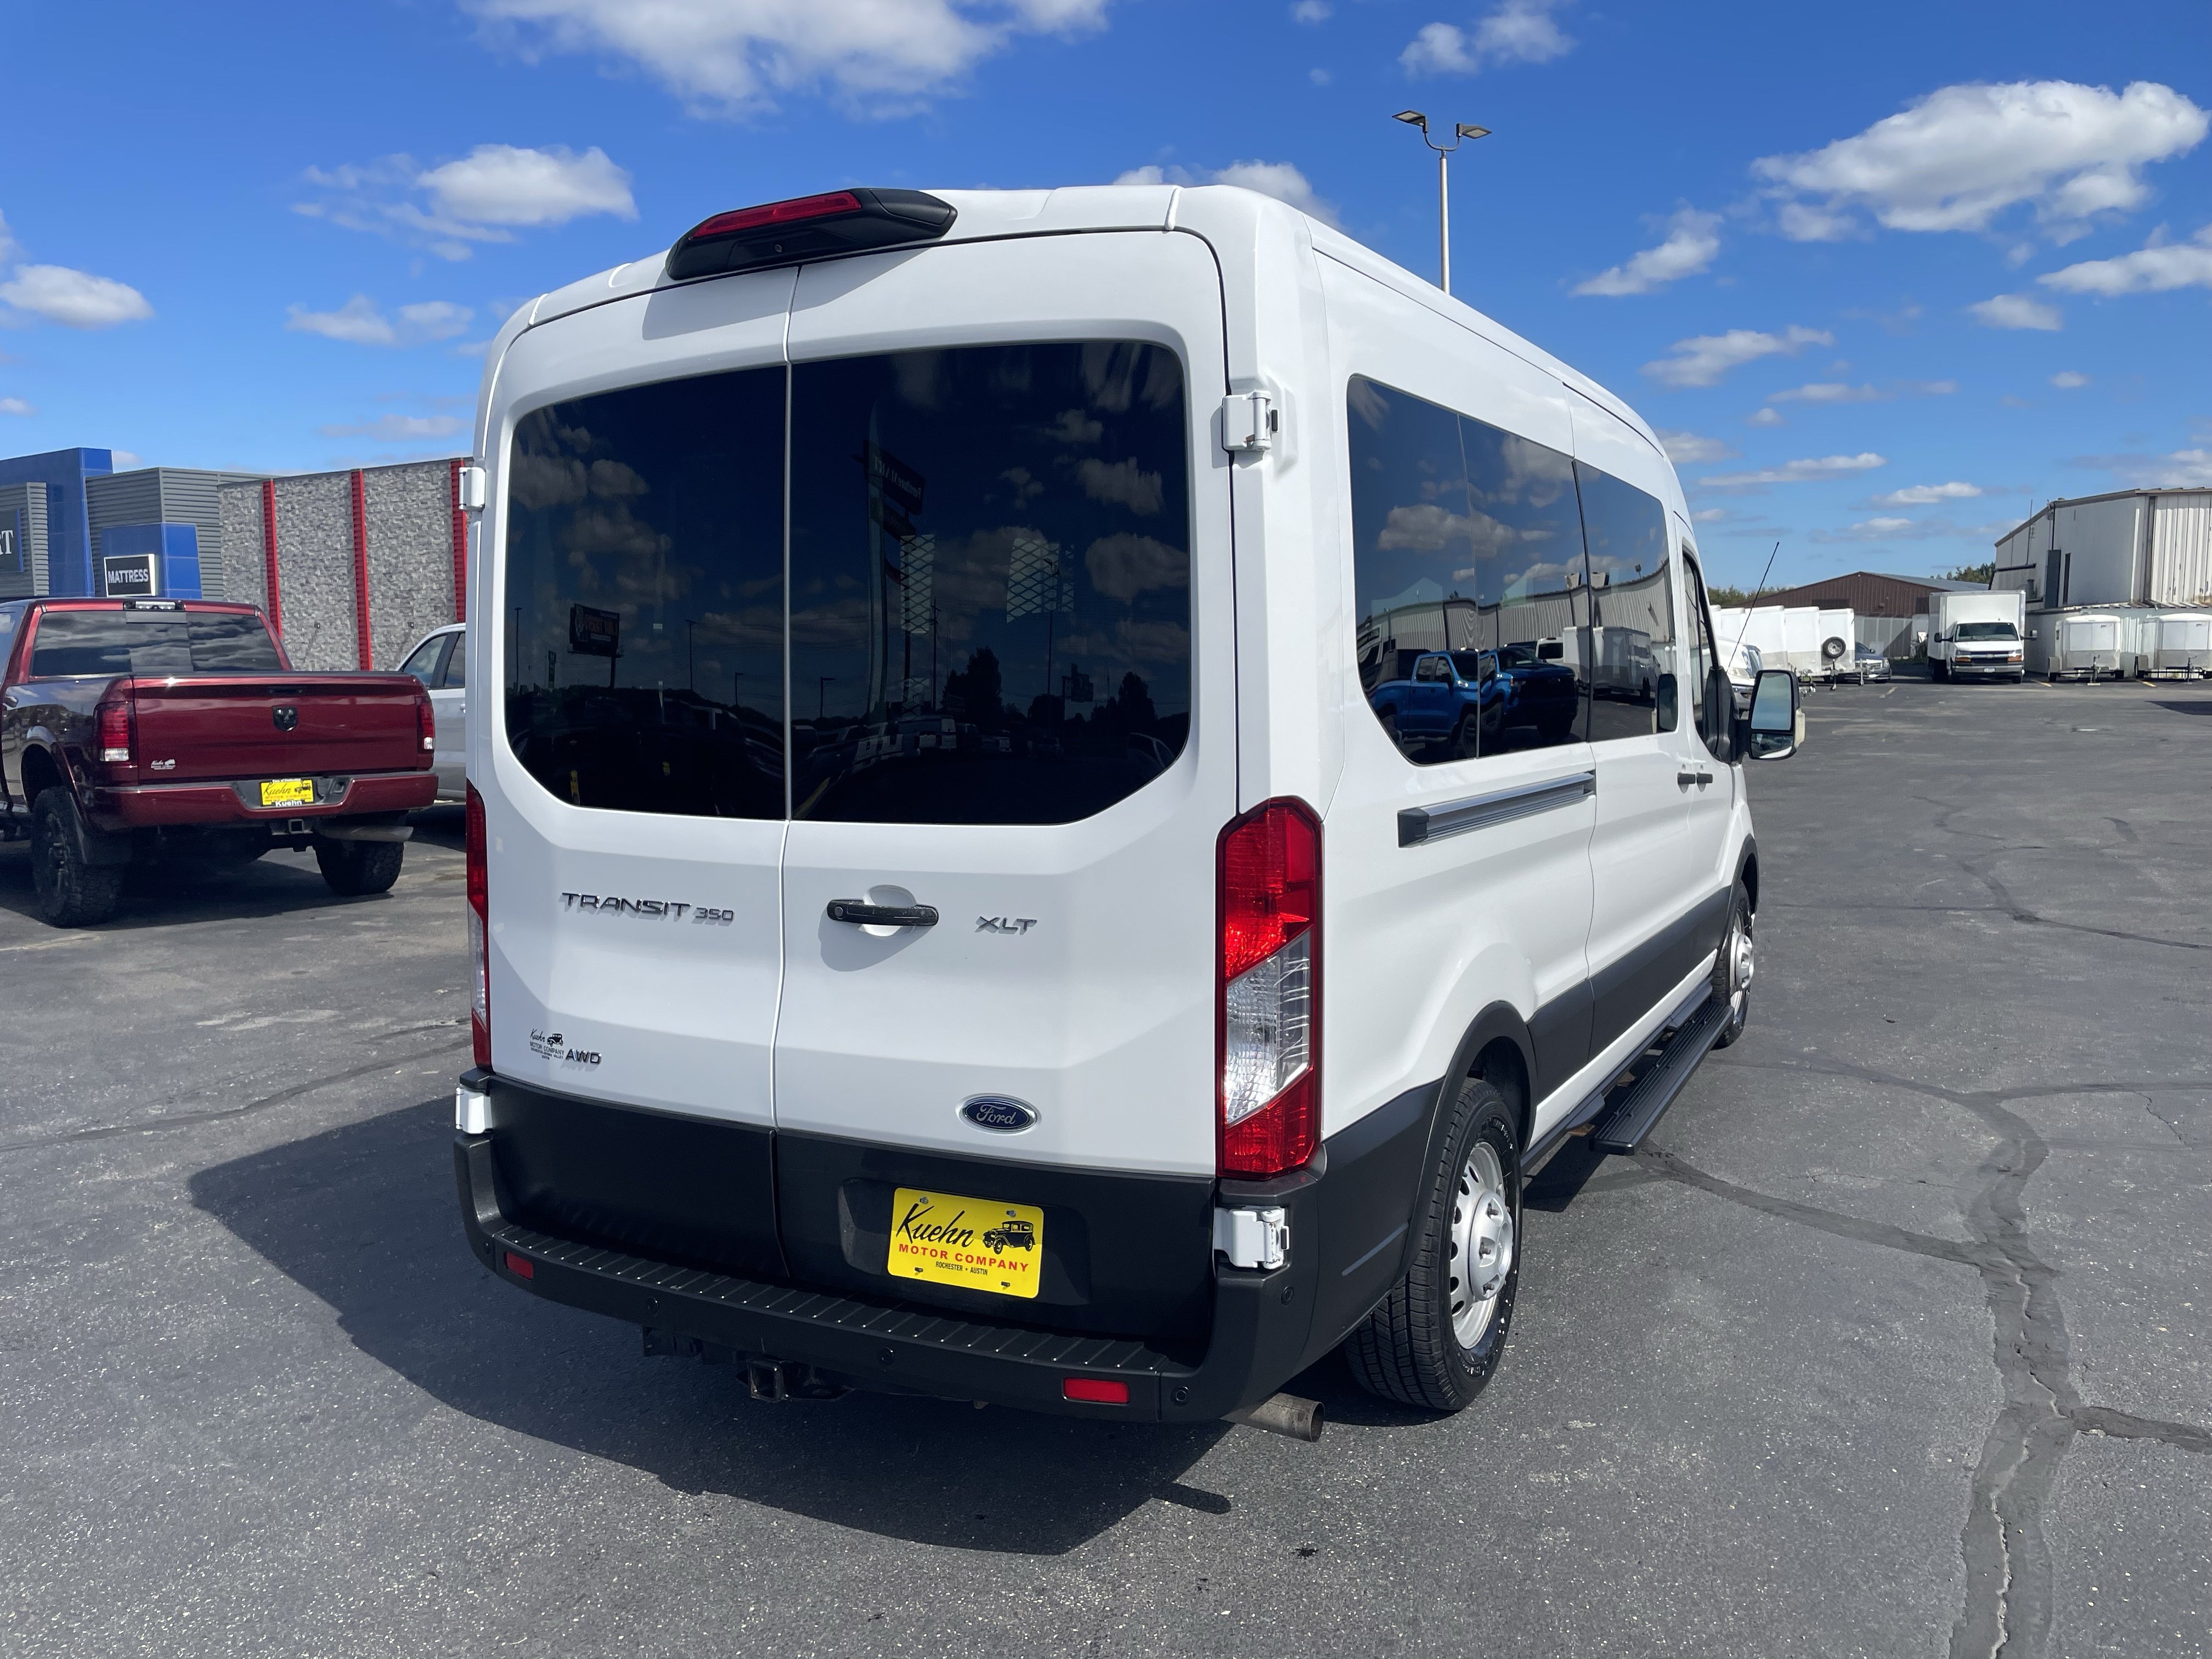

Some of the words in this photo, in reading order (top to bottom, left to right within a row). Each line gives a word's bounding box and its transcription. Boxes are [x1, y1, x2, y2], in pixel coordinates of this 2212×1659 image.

[0, 530, 14, 555] T
[108, 569, 149, 583] MATTRESS
[263, 783, 292, 796] Kuehn
[561, 892, 692, 917] TRANSIT
[695, 907, 735, 921] 350
[978, 916, 1037, 931] XLT
[530, 1028, 545, 1042] Kuehn
[530, 1041, 543, 1049] MOTOR
[544, 1046, 565, 1055] COMPANY
[565, 1048, 602, 1064] AWD
[976, 1104, 1017, 1125] Ford
[895, 1203, 974, 1248] Kuehn
[899, 1243, 948, 1260] MOTOR
[955, 1252, 1030, 1272] COMPANY
[935, 1261, 963, 1272] ROCHESTER
[969, 1266, 988, 1276] AUSTIN
